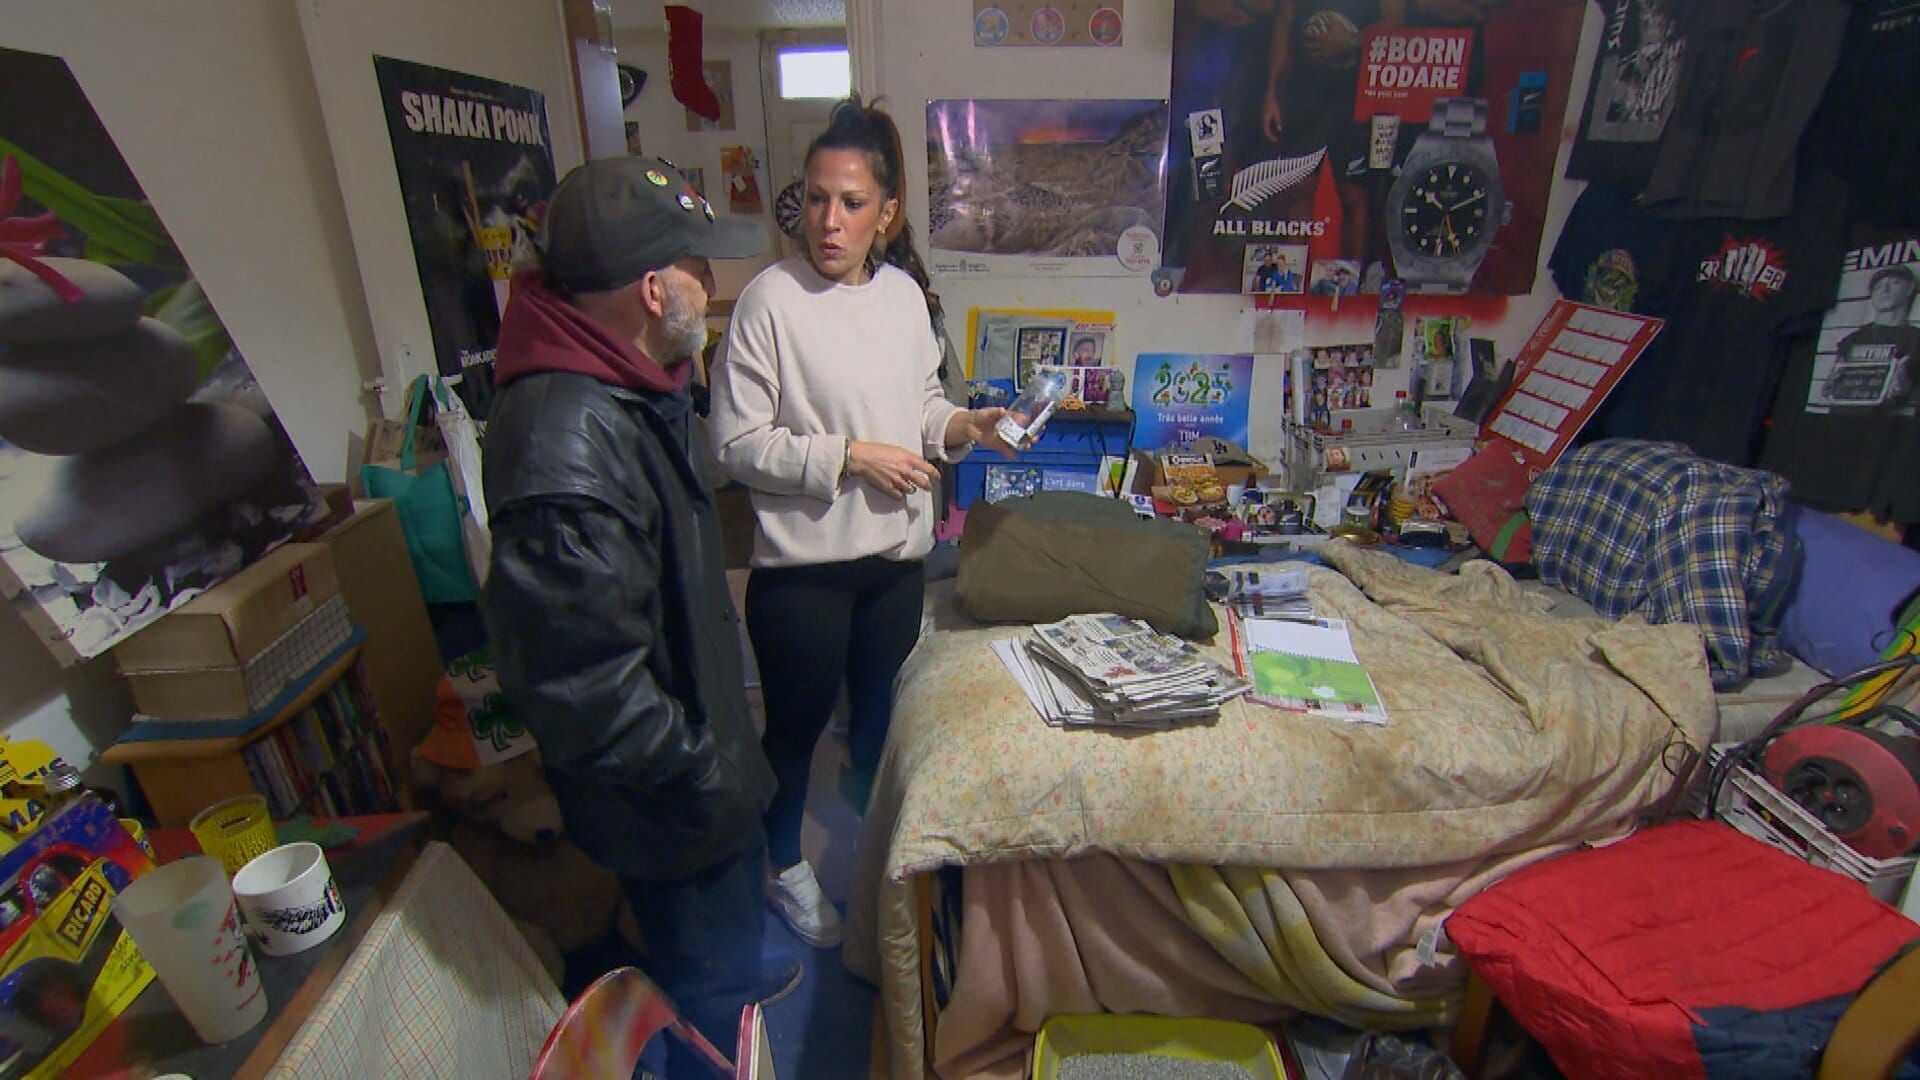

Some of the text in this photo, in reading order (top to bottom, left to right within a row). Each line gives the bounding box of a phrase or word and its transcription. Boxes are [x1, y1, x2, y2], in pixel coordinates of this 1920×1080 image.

[1368, 36, 1466, 65] #BORN
[402, 90, 544, 147] SHAKA PONK
[1213, 219, 1325, 236] ALL BLACKS
[1153, 363, 1233, 406] 2025
[1177, 412, 1198, 423] belle
[63, 882, 103, 943] RICARD
